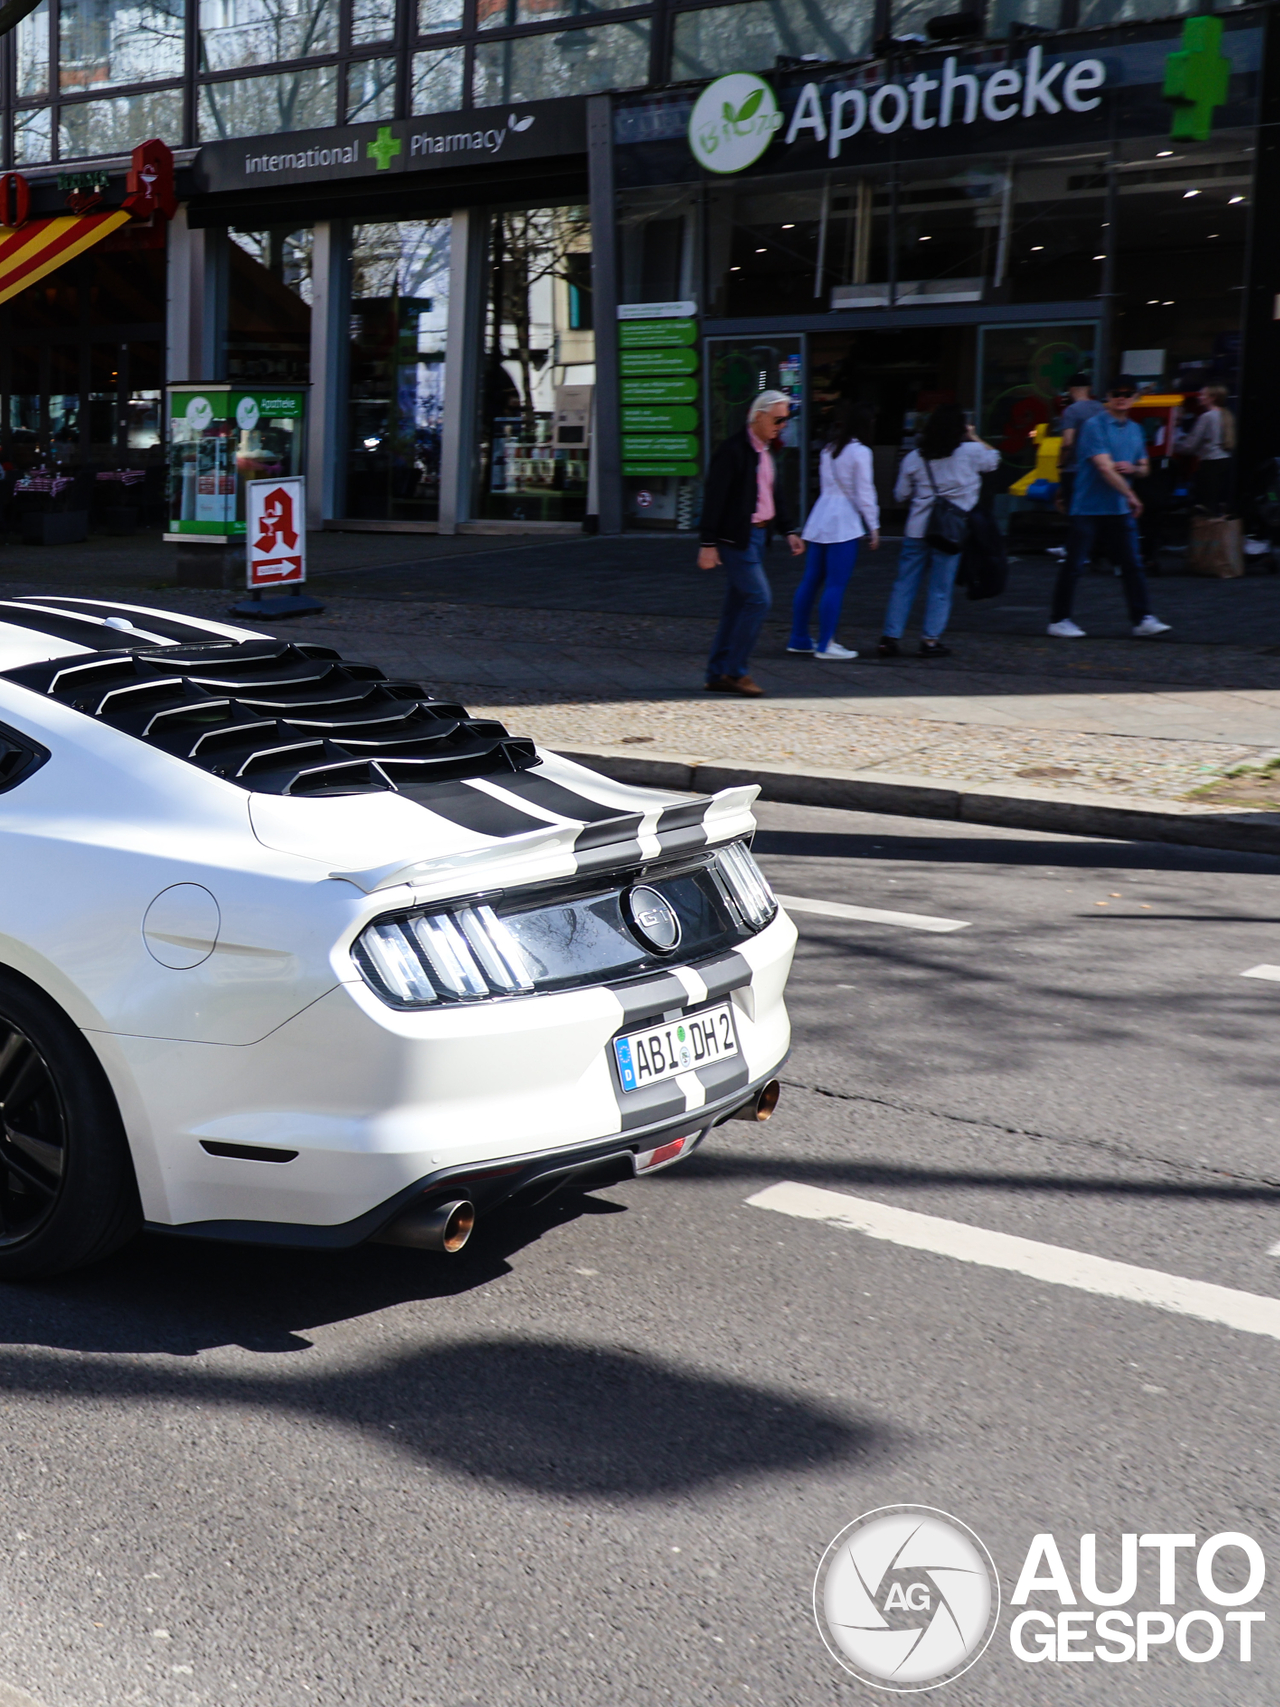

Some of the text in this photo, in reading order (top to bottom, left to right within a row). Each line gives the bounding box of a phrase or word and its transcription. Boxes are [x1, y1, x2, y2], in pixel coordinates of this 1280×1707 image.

[785, 45, 1106, 159] Apotheke
[245, 127, 507, 175] international Pharmacy
[640, 905, 668, 927] GT
[637, 1013, 735, 1081] ABI DH 2
